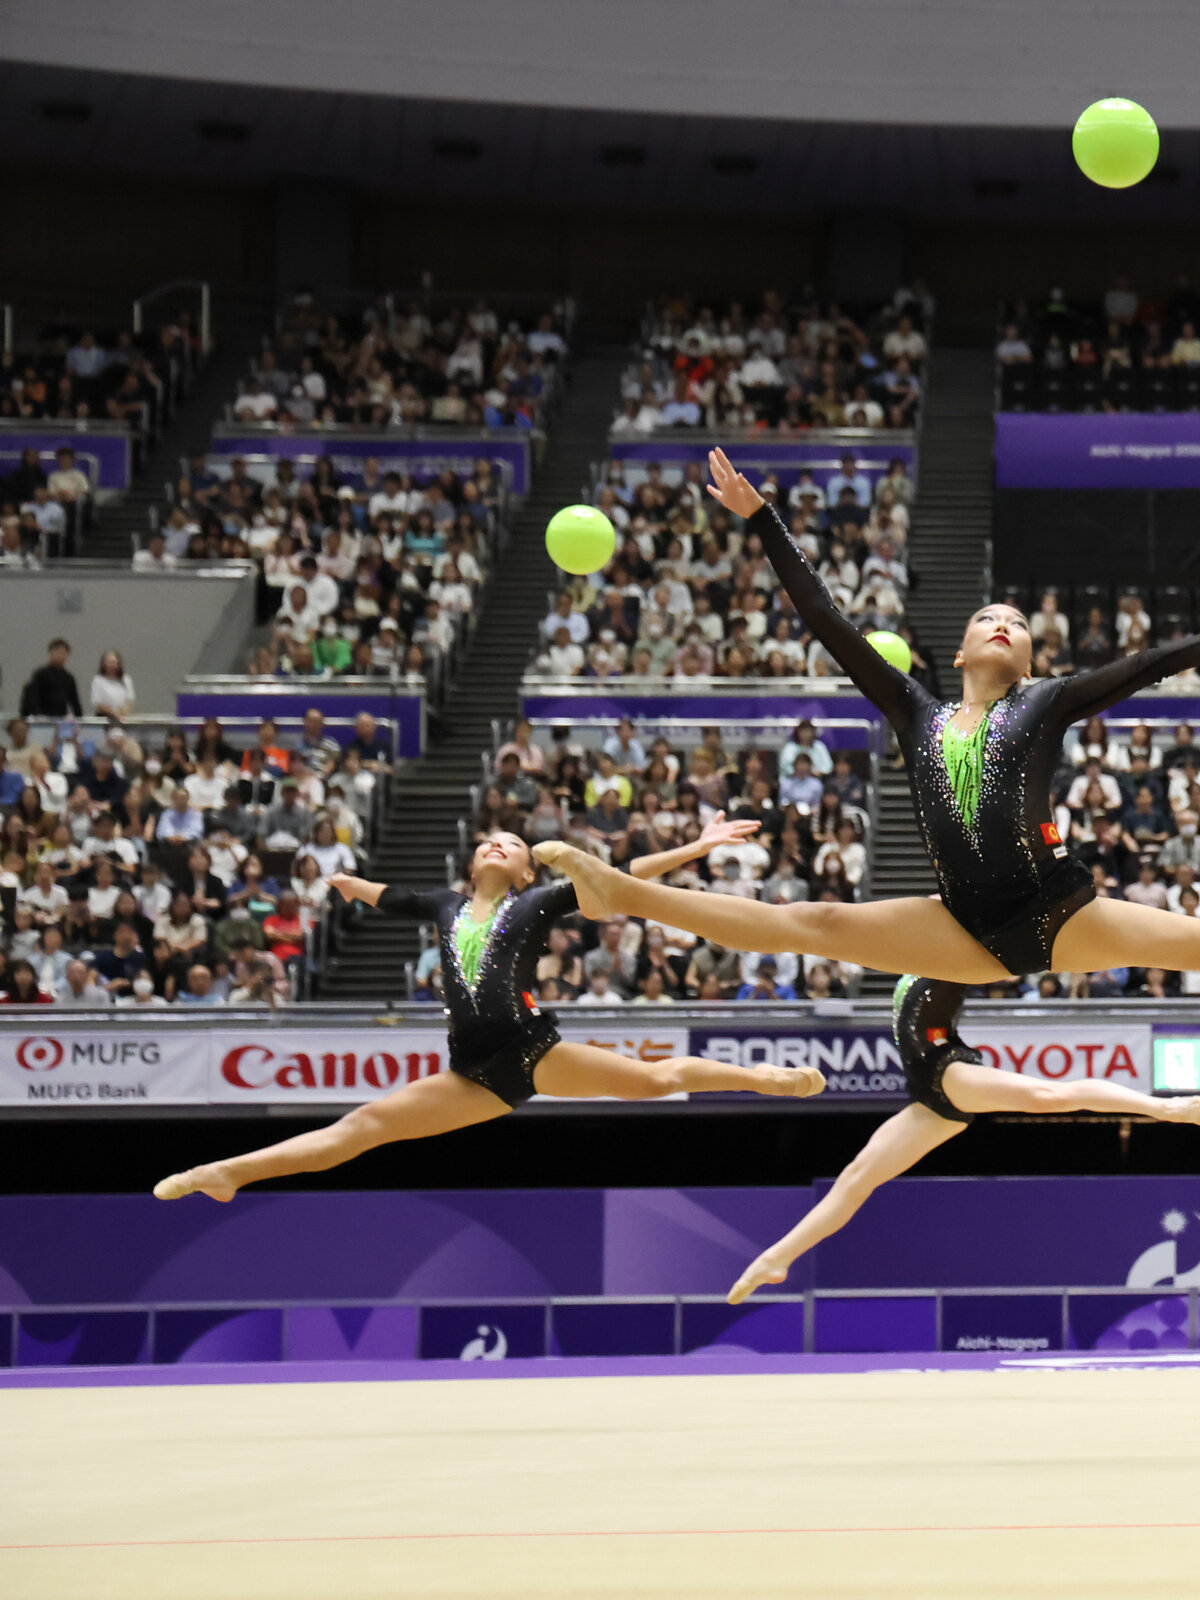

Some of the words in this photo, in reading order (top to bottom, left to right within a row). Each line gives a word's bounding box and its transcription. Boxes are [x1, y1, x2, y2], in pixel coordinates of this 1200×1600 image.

[71, 1042, 160, 1065] MUFG
[221, 1043, 441, 1090] Canon
[28, 1083, 91, 1099] MUFG
[98, 1082, 148, 1099] Bank
[827, 1073, 908, 1092] NOLOGY
